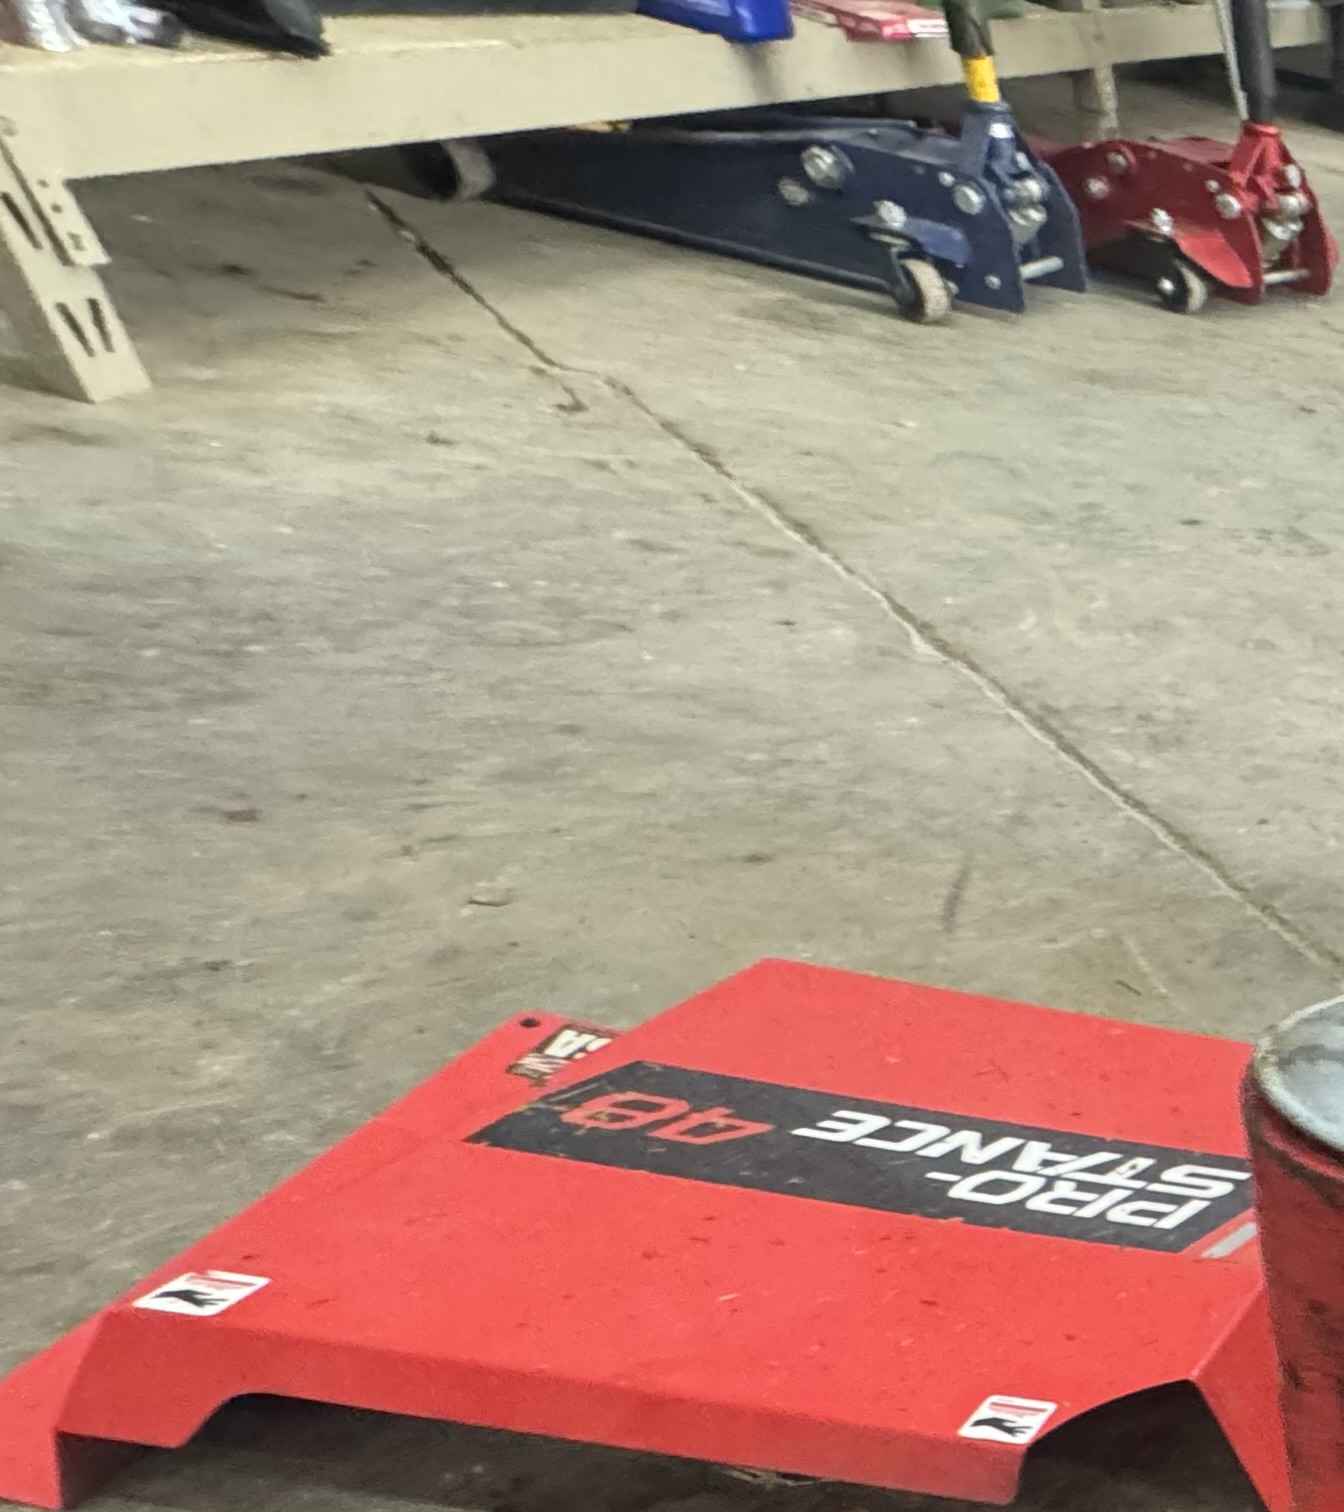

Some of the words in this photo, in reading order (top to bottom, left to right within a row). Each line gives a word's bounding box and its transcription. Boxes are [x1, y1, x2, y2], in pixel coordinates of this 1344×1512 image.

[560, 1091, 774, 1145] 48
[789, 1110, 1252, 1198] STANCE
[924, 1169, 1212, 1230] PRO-
